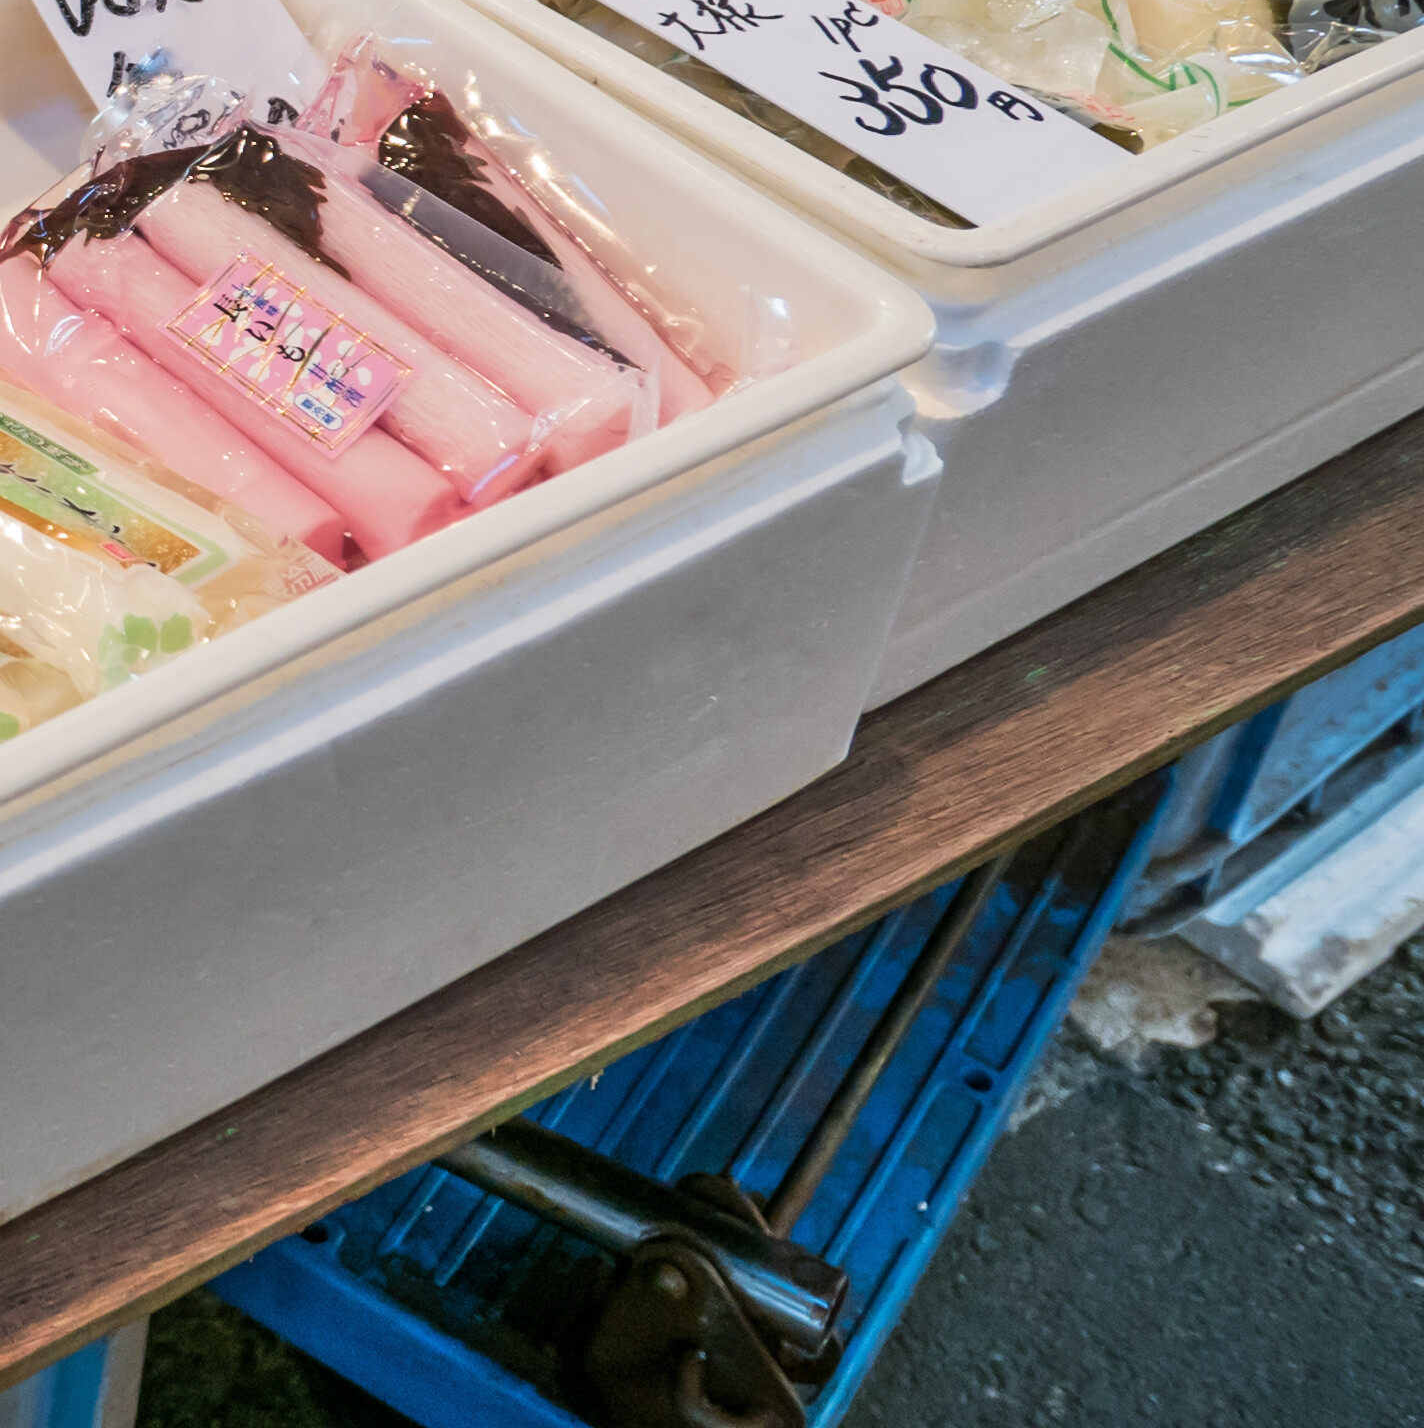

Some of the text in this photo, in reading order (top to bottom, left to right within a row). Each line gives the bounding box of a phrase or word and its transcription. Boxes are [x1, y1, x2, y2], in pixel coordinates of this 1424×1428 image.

[818, 56, 1044, 135] 350円
[213, 292, 306, 362] 長いも
